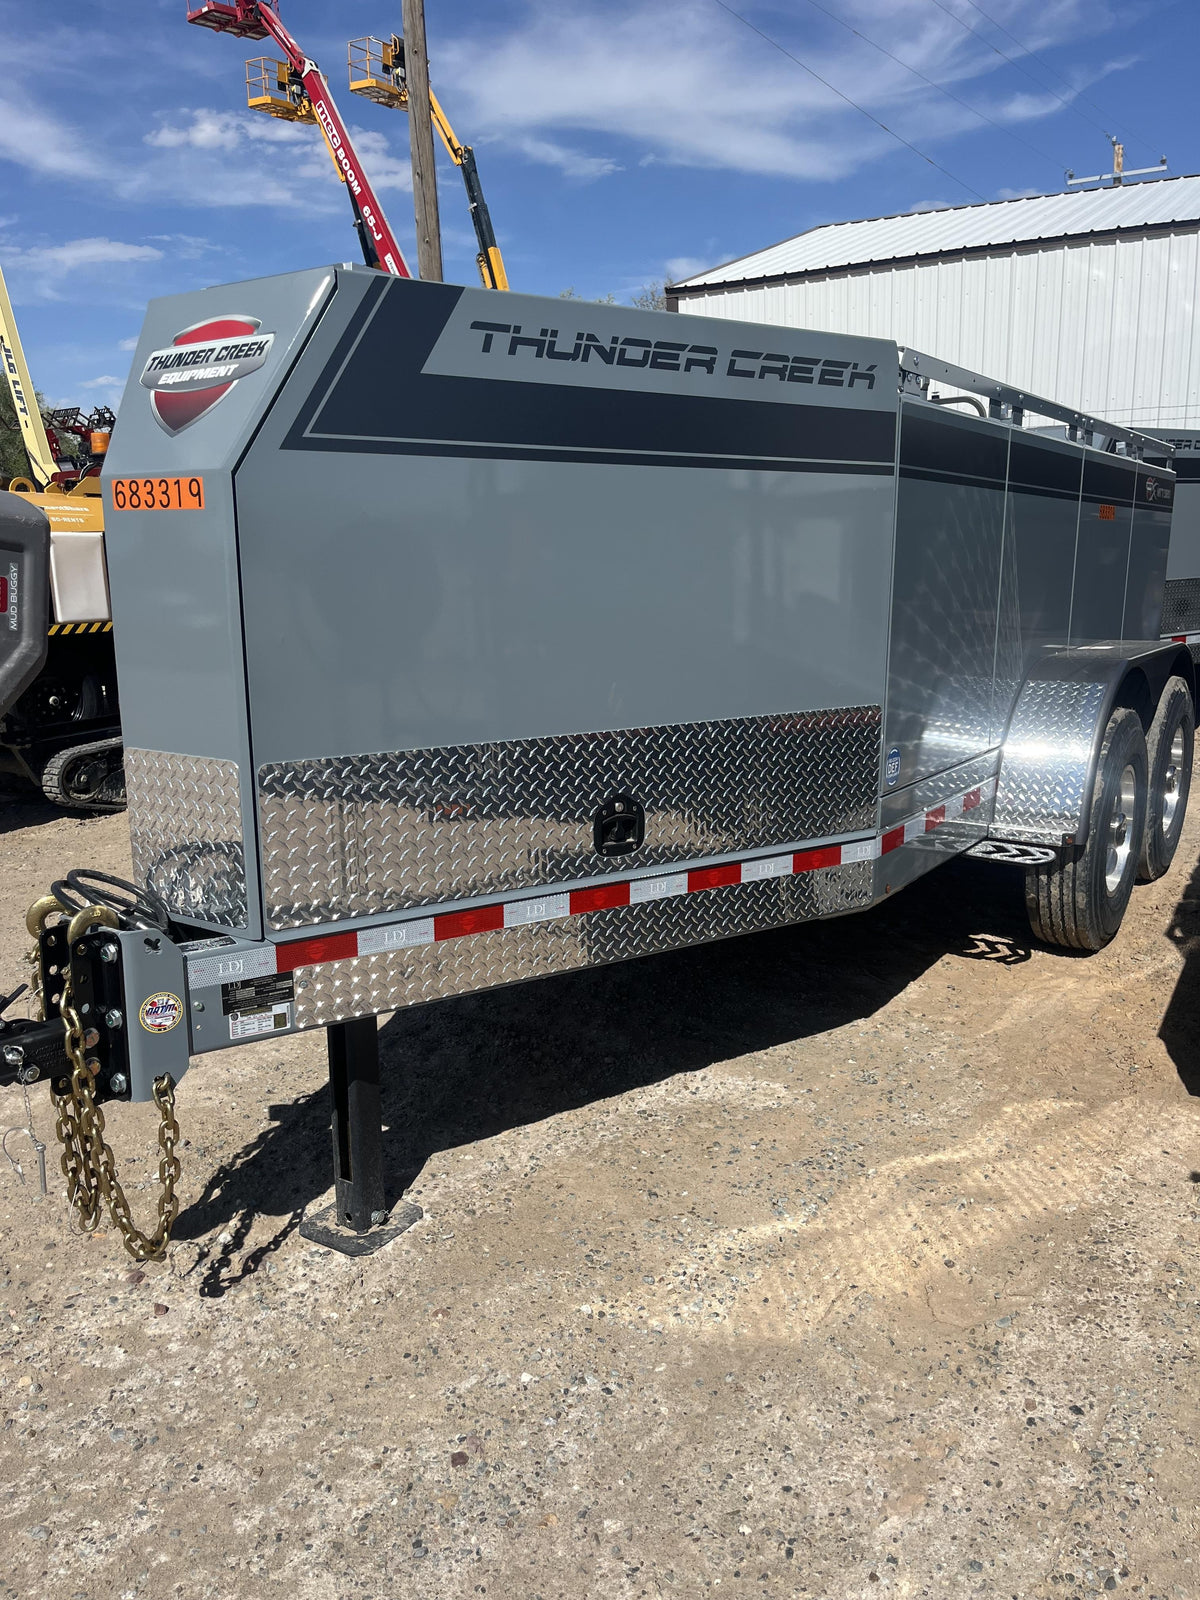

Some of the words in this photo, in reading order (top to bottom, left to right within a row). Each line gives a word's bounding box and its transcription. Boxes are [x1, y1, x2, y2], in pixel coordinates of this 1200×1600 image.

[337, 147, 361, 196] BOOM
[362, 205, 382, 242] 65-J
[147, 347, 217, 372] THUNDER
[213, 340, 270, 363] CREEK
[469, 320, 718, 374] THUNDER
[726, 349, 878, 390] CREEK
[3, 344, 17, 375] JLG
[12, 379, 28, 416] LIFT
[157, 364, 240, 385] EQUIPMENT
[114, 478, 203, 509] 683319
[10, 565, 18, 603] BUGGY
[10, 605, 18, 631] MUD
[758, 863, 775, 875] LDJ
[649, 881, 668, 894] LDJ
[526, 903, 547, 917] LDJ
[384, 929, 408, 944] LDJ
[218, 959, 245, 975] LDJ
